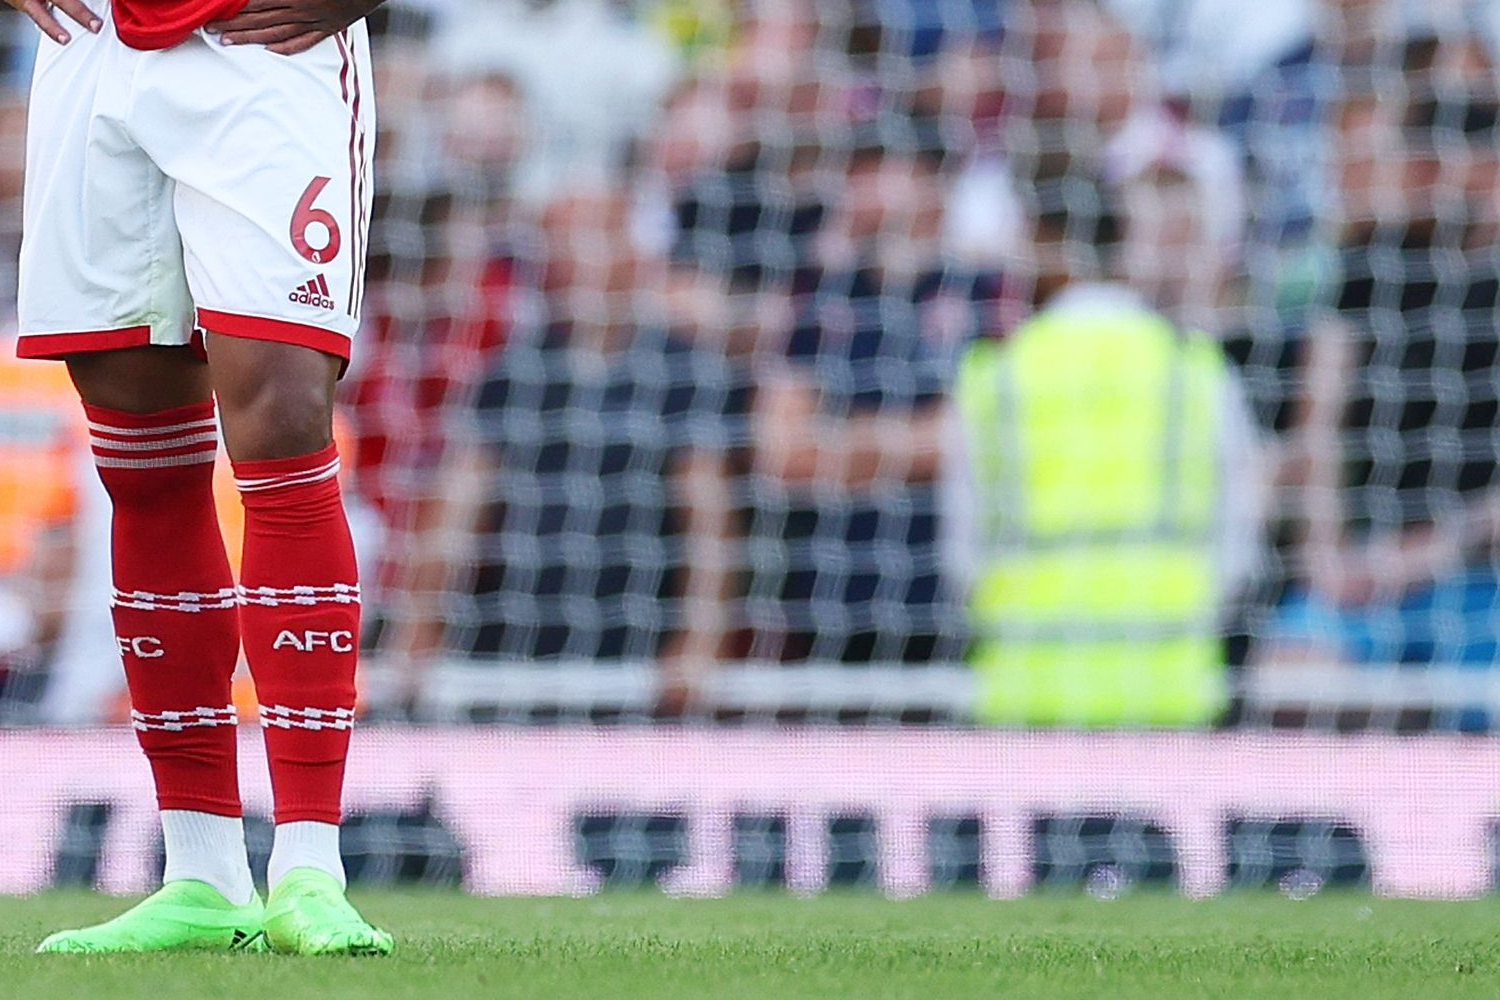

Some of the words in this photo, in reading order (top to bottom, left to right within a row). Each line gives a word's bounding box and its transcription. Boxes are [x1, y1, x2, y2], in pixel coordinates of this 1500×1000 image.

[290, 175, 341, 264] 6
[288, 290, 335, 310] adidas
[116, 635, 164, 658] FC
[273, 630, 352, 652] AFC
